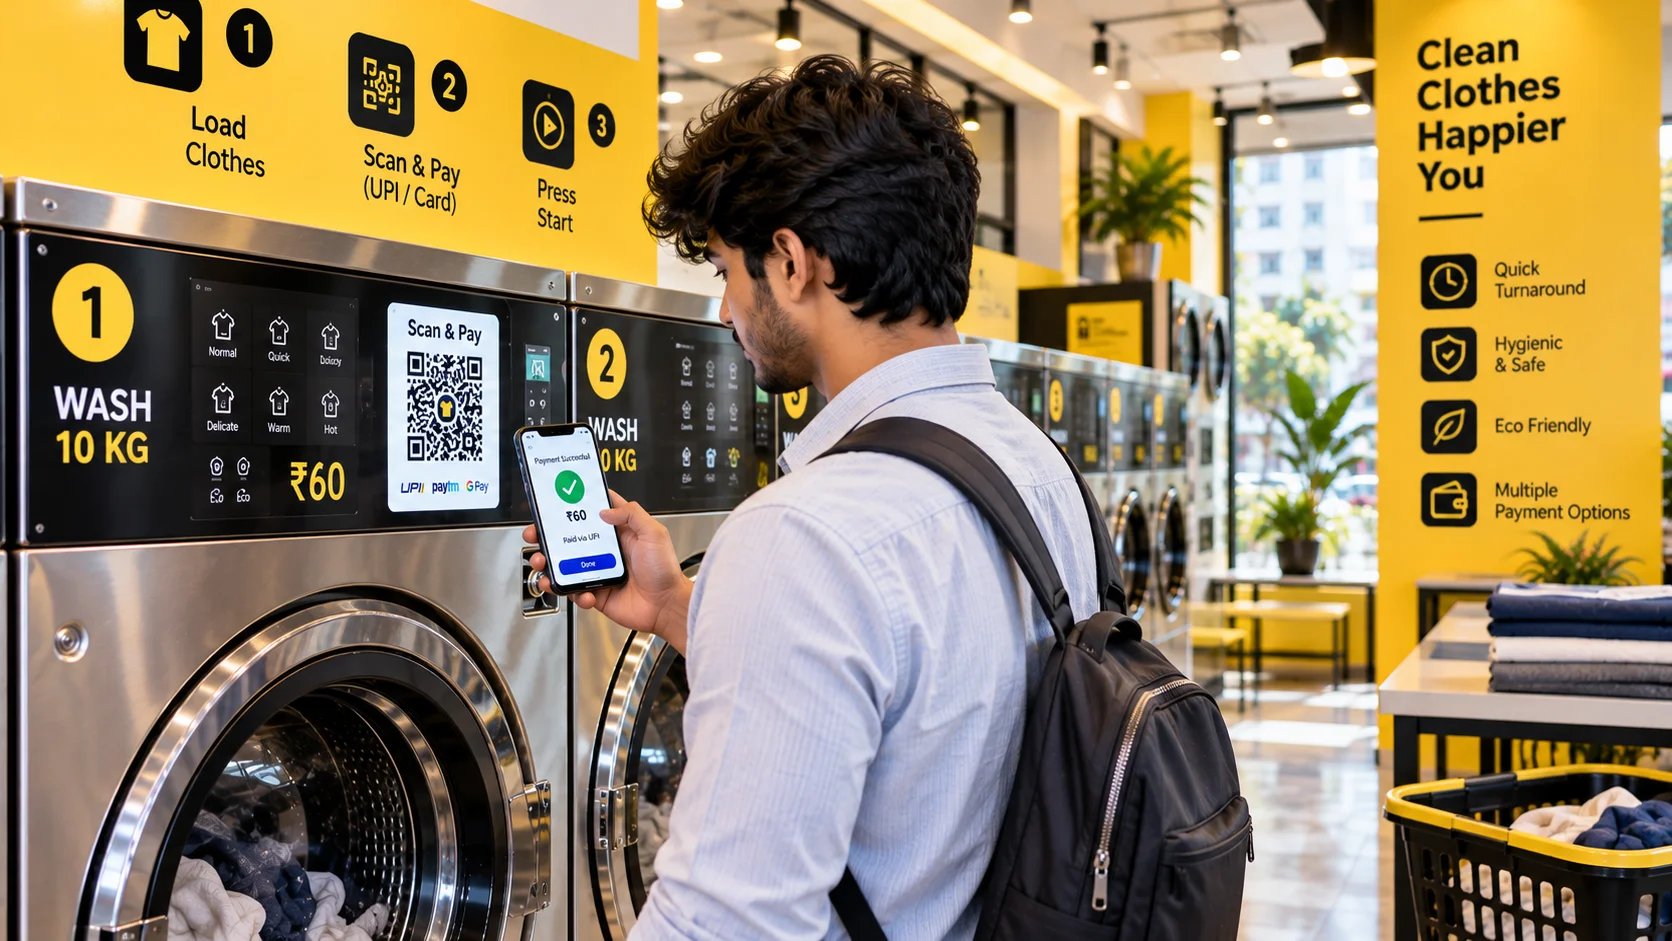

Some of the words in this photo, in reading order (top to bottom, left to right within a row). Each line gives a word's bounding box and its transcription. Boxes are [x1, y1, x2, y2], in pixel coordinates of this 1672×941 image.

[243, 23, 256, 54] 1
[1416, 37, 1519, 71] Clean
[442, 72, 457, 101] 2
[1417, 72, 1561, 112] Clothes
[191, 105, 247, 141] Load
[595, 113, 608, 138] 3
[1417, 111, 1567, 156] Happier
[185, 141, 266, 178] Clothes
[363, 143, 408, 174] Scan
[412, 153, 427, 178] &
[430, 157, 461, 190] Pay
[1417, 161, 1484, 192] You
[363, 174, 401, 203] (UPI
[403, 184, 413, 207] /
[414, 186, 458, 217] Card)
[537, 177, 578, 206] Press
[537, 207, 575, 234] Start
[1494, 259, 1540, 279] Quick
[1494, 278, 1586, 299] Turnaround
[81, 285, 102, 339] 1
[407, 318, 441, 339] Scan
[443, 322, 456, 340] &
[459, 324, 482, 347] Pay
[1494, 334, 1563, 356] Hygienic
[208, 346, 237, 358] Normal
[267, 350, 291, 363] Quick
[599, 343, 615, 383] 2
[1494, 357, 1507, 373] &
[1511, 355, 1546, 373] Safe
[53, 385, 152, 423] WASH
[206, 420, 239, 432] Delicate
[267, 422, 291, 433] Warm
[323, 424, 338, 435] Hot
[587, 416, 638, 442] WASH
[1494, 417, 1524, 434] Eco
[1528, 416, 1592, 437] Friendly
[55, 429, 95, 464] 10
[104, 430, 149, 465] KG
[614, 448, 637, 472] KG
[290, 460, 346, 502] ₹60
[431, 480, 459, 495] paytm
[474, 480, 489, 494] Pay
[1494, 481, 1559, 502] Multiple
[565, 509, 587, 523] ₹60
[1494, 503, 1564, 523] Payment
[1567, 503, 1631, 524] Options
[562, 534, 578, 544] Paid
